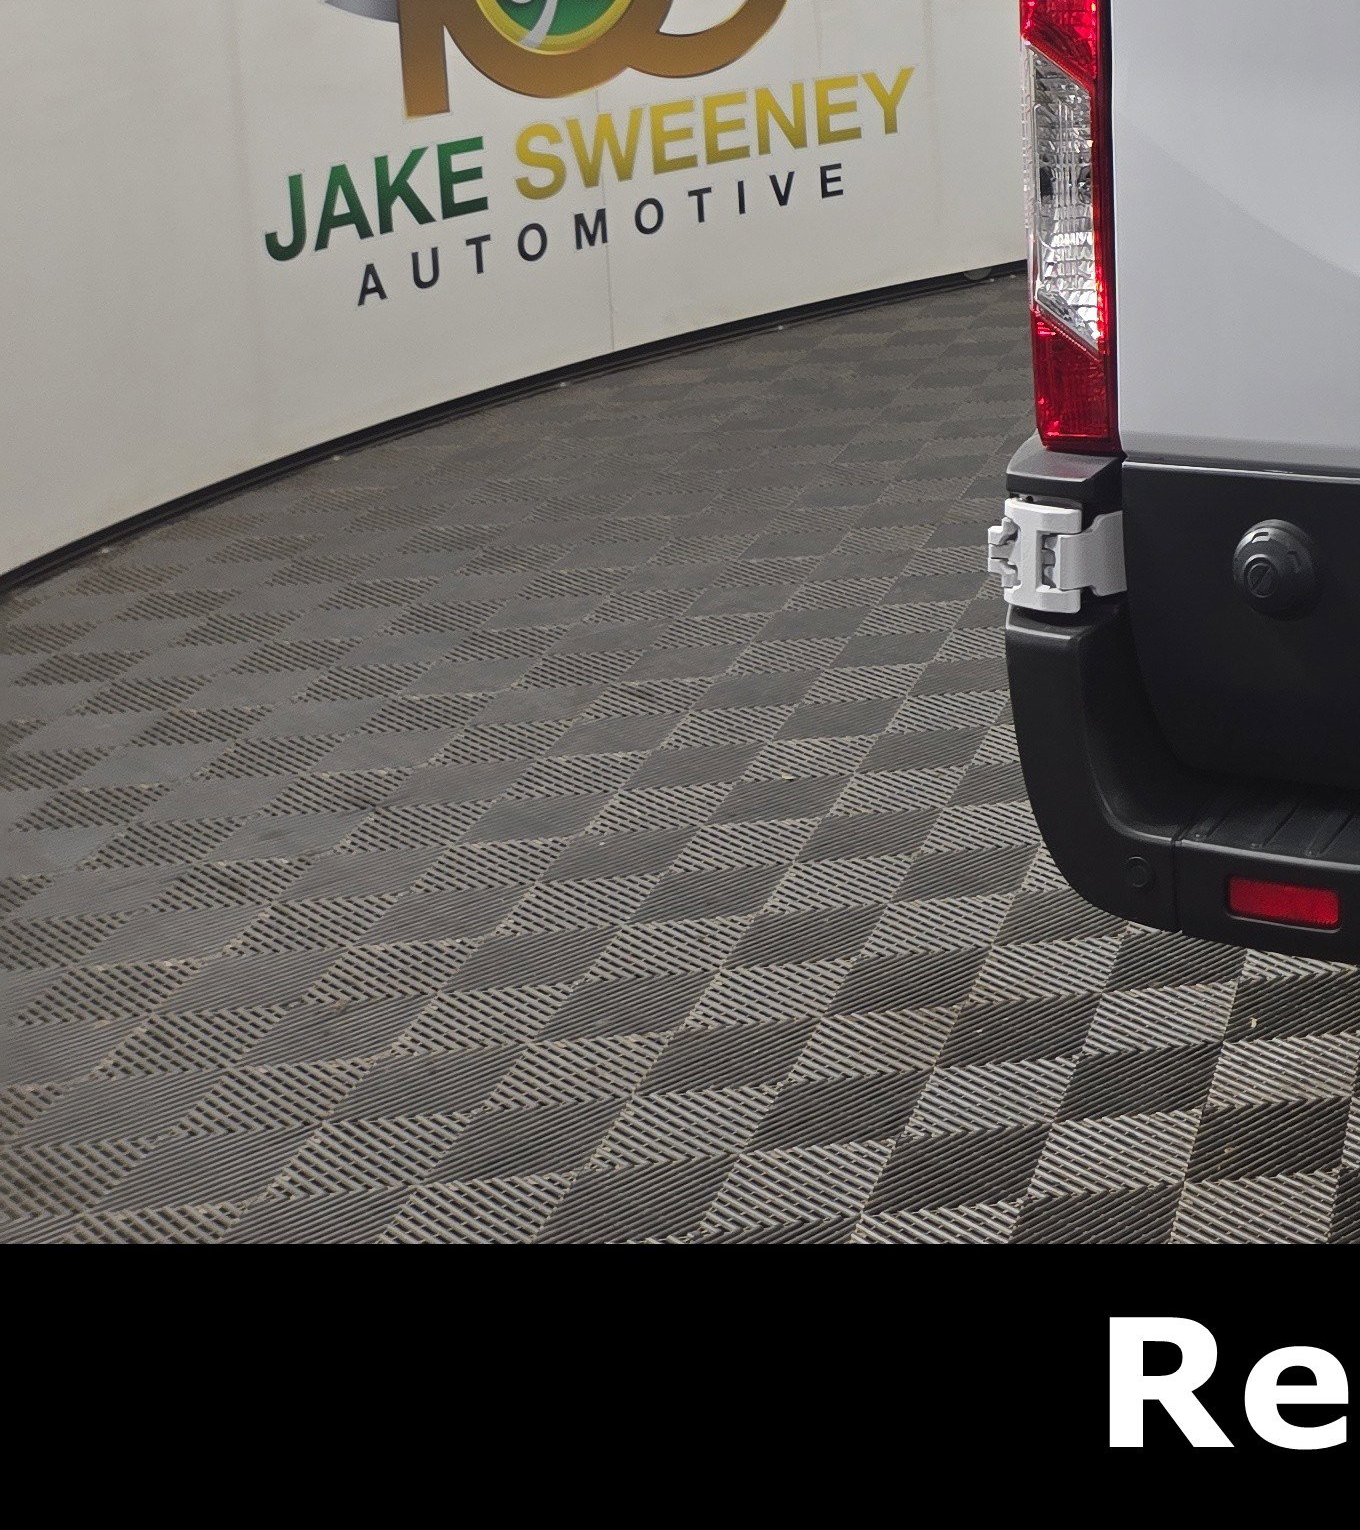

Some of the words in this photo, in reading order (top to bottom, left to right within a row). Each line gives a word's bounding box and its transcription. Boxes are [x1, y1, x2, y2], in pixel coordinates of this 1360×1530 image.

[264, 136, 489, 262] JAKE
[513, 67, 915, 202] SWEENEY
[356, 163, 844, 306] AUTOMOTIVE
